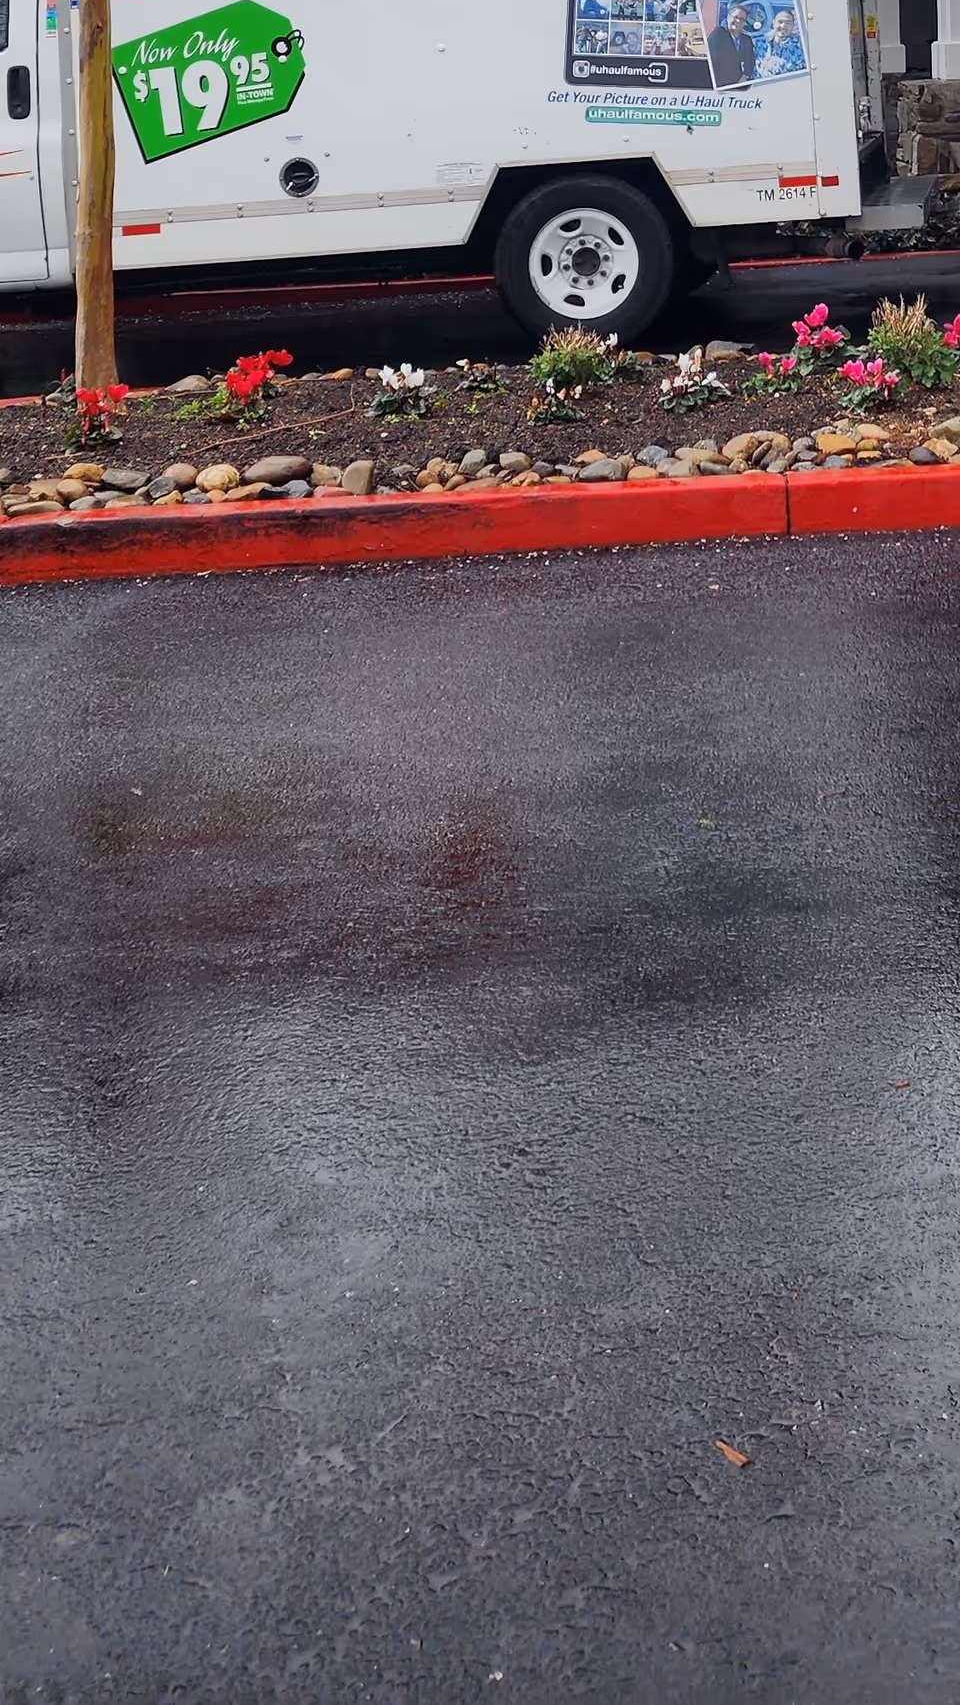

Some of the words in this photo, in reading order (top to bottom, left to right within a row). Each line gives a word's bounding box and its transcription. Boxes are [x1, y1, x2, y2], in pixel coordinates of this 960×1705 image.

[131, 38, 178, 66] Now
[183, 28, 239, 62] Only
[590, 64, 662, 77] #uhaulfamous
[236, 88, 274, 101] IN-TOWN
[547, 91, 569, 103] Get
[573, 92, 600, 104] Your
[603, 92, 648, 106] Picture
[651, 96, 666, 105] on
[669, 97, 677, 106] a
[680, 96, 724, 108] U-Haul
[728, 97, 763, 109] Truck
[588, 109, 719, 122] uhaulfamous.com
[756, 189, 775, 201] TM
[779, 187, 806, 199] 2614
[809, 186, 817, 198] F
